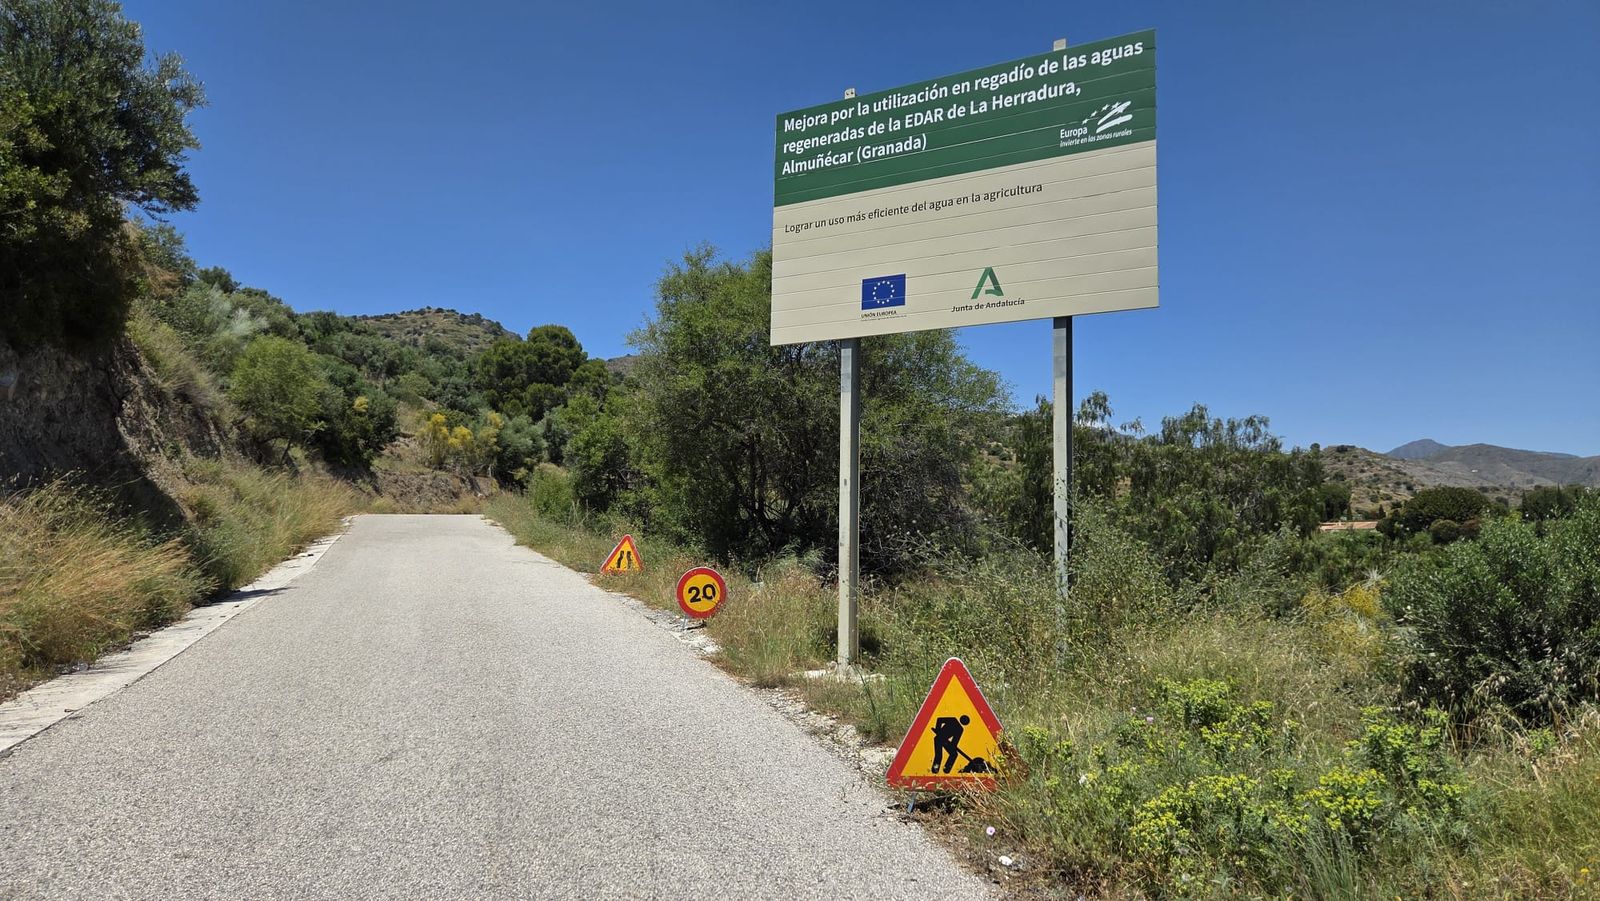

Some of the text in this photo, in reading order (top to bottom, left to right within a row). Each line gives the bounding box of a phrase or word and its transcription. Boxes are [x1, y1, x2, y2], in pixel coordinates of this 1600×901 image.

[784, 42, 1143, 132] Mejora por la utilización en regadío de las aguas
[783, 81, 1081, 154] regeneradas de la EDAR de La Herradura,
[1060, 127, 1088, 139] Europa
[1060, 138, 1080, 147] invierte
[1097, 133, 1112, 141] zonas
[1113, 128, 1132, 138] rurales
[782, 133, 927, 175] Almuñécar (Granada)
[785, 183, 1043, 234] Lograr un uso más eficiente del agua en la agricultura
[951, 305, 973, 313] Junta
[985, 297, 1025, 309] Andalucía
[688, 583, 716, 603] 20
